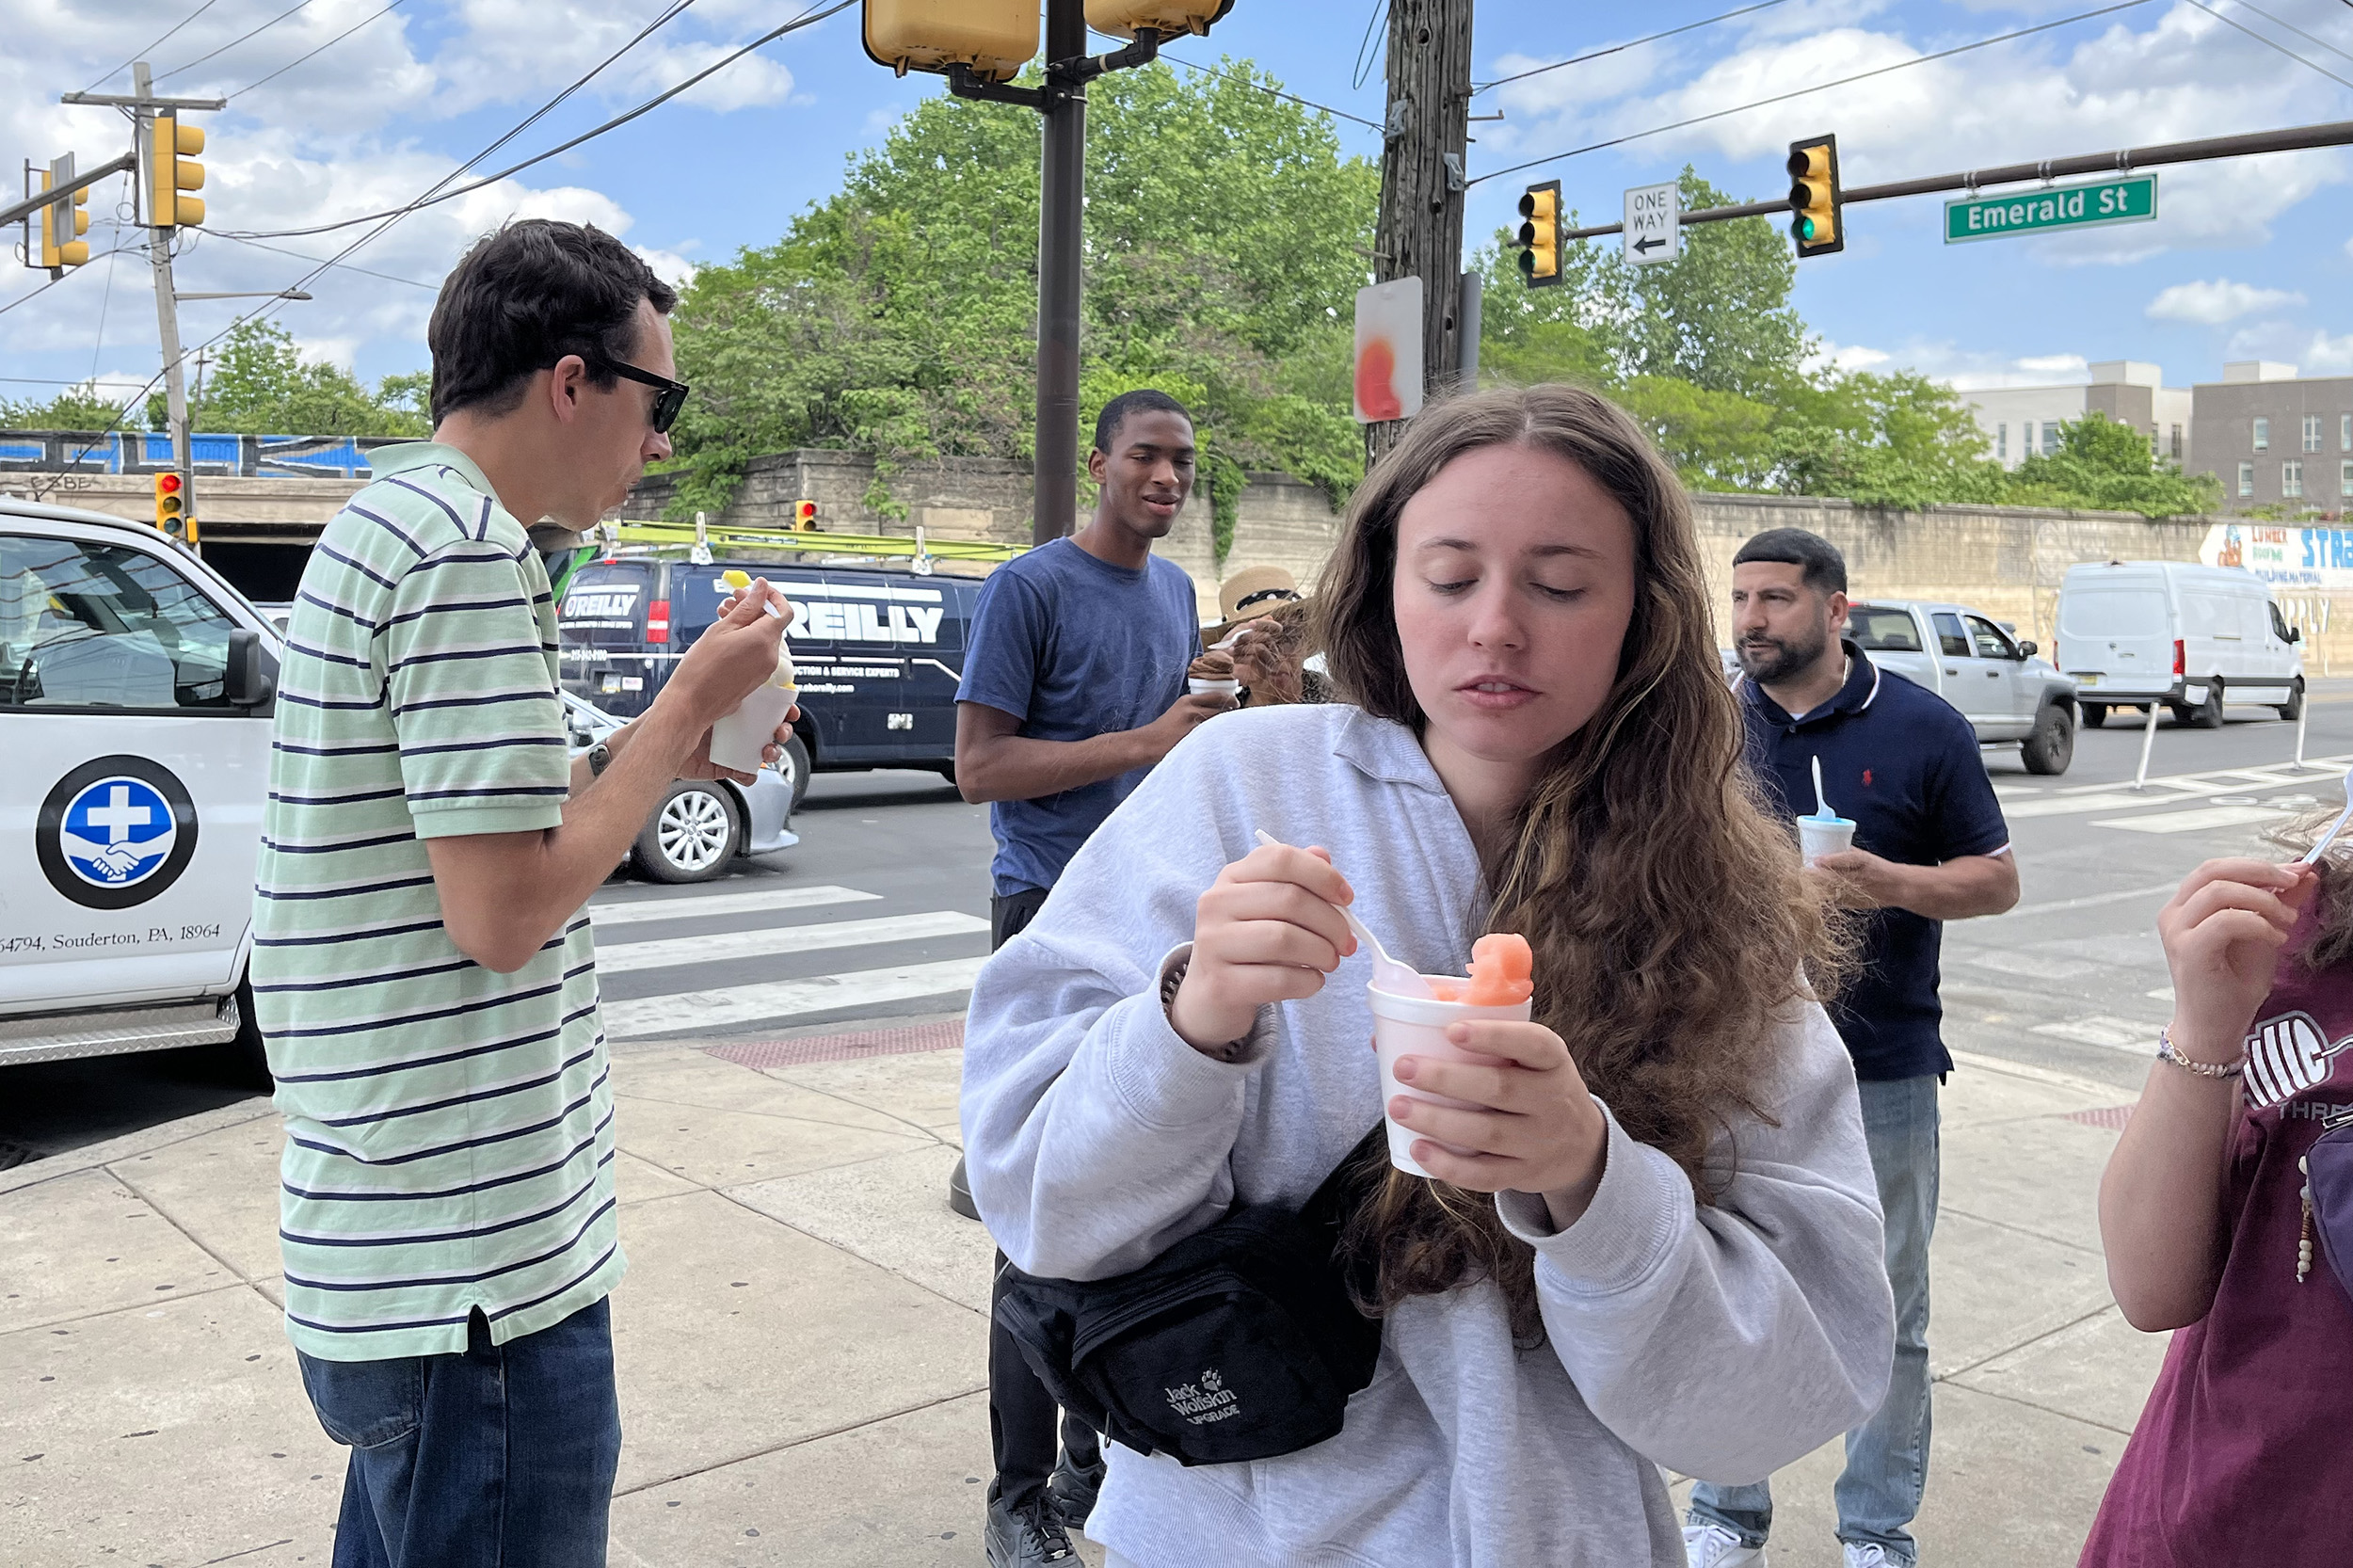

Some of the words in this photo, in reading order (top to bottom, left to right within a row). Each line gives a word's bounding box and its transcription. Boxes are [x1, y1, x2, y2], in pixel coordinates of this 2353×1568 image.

[1635, 191, 1667, 210] ONE
[1968, 191, 2085, 231] Emerald
[2099, 186, 2128, 214] St
[1633, 210, 1668, 231] WAY
[718, 597, 944, 644] REILLY
[831, 666, 864, 677] SERVICE
[865, 668, 900, 678] EXPERTS
[53, 933, 141, 950] Souderton,
[149, 927, 173, 941] PA,
[180, 924, 220, 940] 18964
[1164, 1384, 1201, 1403] Jack
[1170, 1389, 1238, 1416] Wolfskin
[1186, 1404, 1241, 1425] UPGRADE
